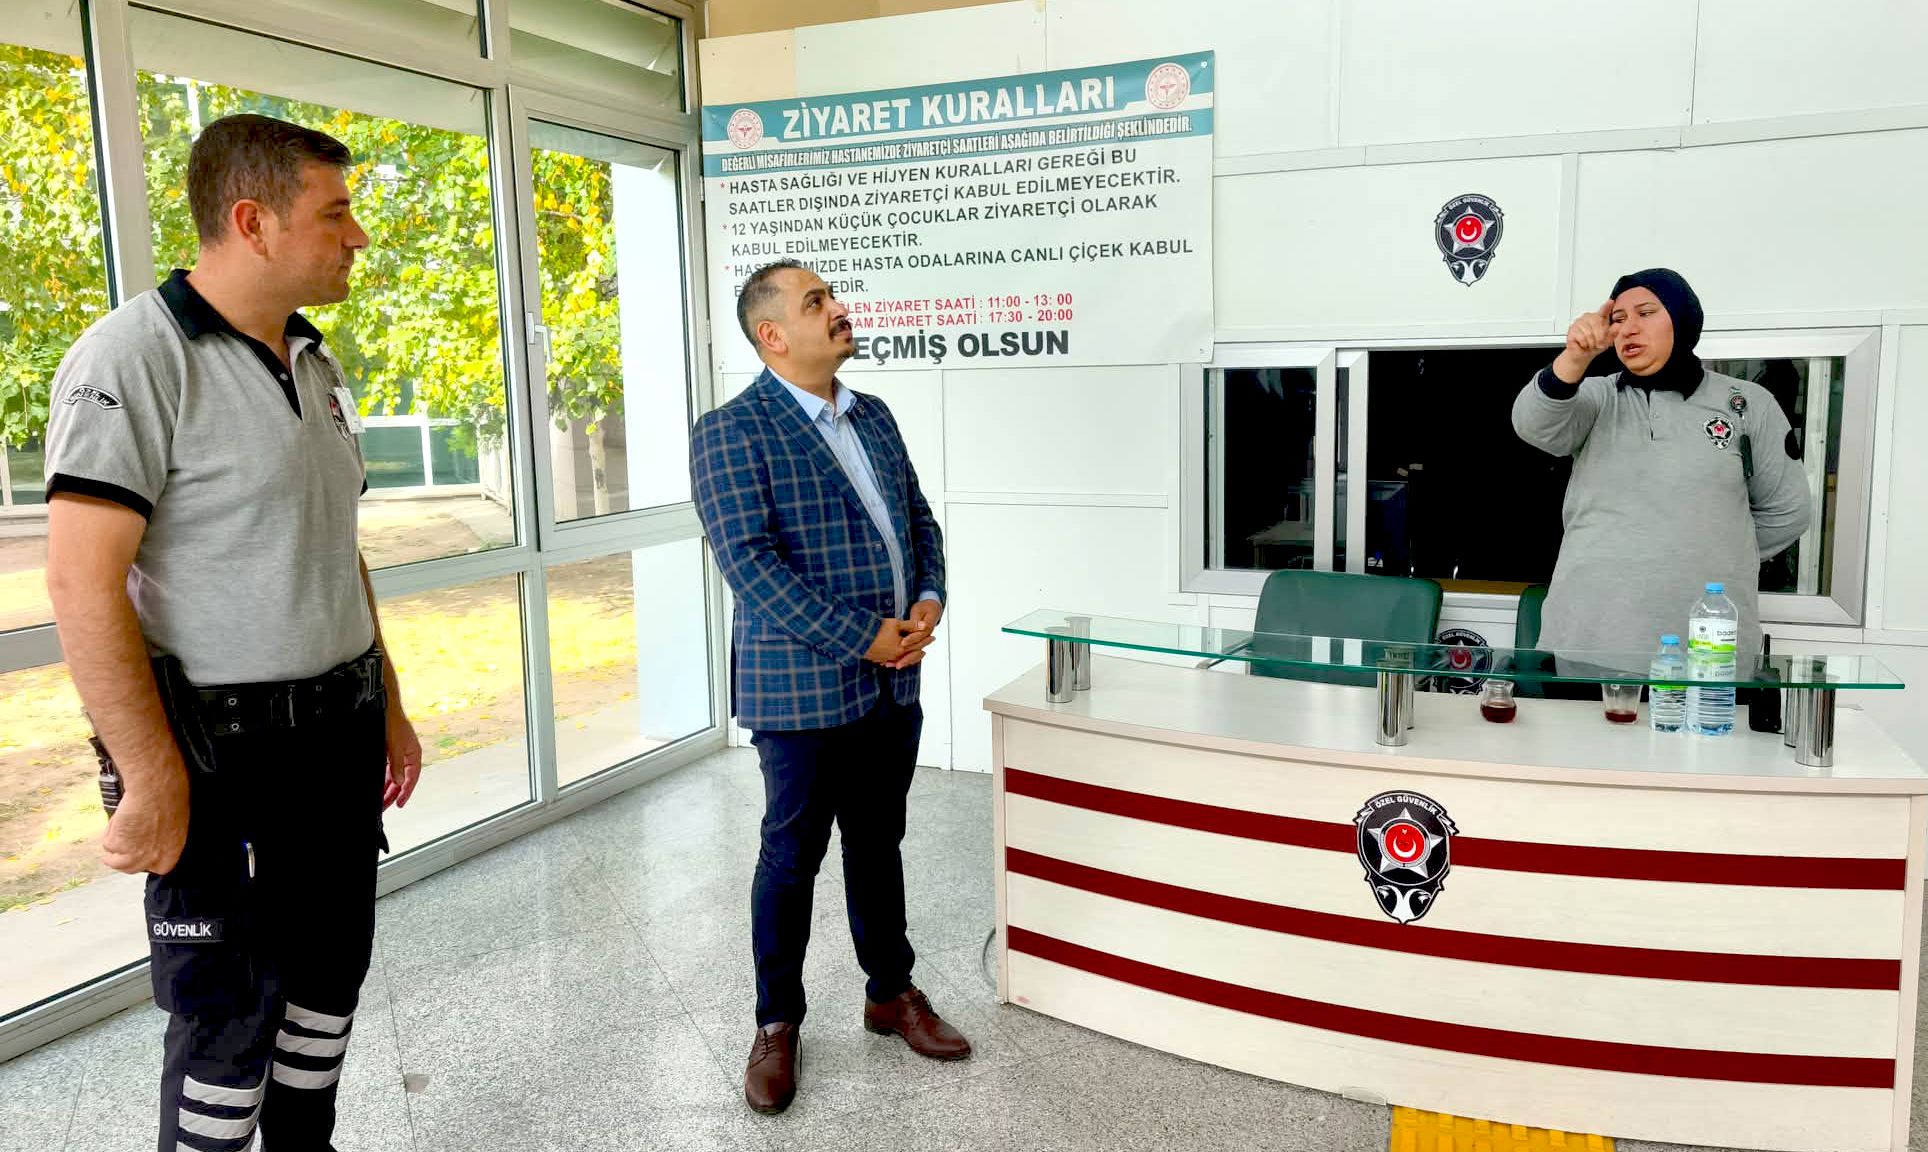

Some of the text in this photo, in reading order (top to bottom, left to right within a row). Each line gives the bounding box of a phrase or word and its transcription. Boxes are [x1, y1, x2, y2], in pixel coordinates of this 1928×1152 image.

[783, 76, 1114, 138] ZİYARET KURALLARI
[721, 155, 756, 172] DEĞERLİ
[831, 143, 900, 164] HASTANEMİZDE
[903, 137, 953, 157] ZİYARETÇİ
[953, 132, 999, 153] SAATLERİ
[1001, 130, 1046, 151] AŞAĞIDA
[1049, 118, 1115, 145] BELİRTİLDİĞİ
[1117, 115, 1193, 140] ŞEKLİNDEDİR.
[730, 148, 1136, 194] HASTA SAĞLIĞI VE HİJYEN KURALLARI GEREĞİ BU
[729, 167, 1180, 215] SAATLER DIŞINDA ZİYARETÇİ KABUL EDİLMEYECEKTİR.
[732, 194, 1157, 236] 12 YAŞINDAN KÜÇÜK ÇOCUKLAR ZİYARETÇİ OLARAK
[732, 231, 922, 256] KABUL EDİLMEYECEKTİR.
[852, 256, 903, 271] HASTA
[908, 250, 1006, 268] ODALARINA
[1011, 246, 1063, 262] CANLI
[1070, 242, 1123, 263] ÇİÇEK
[1130, 240, 1193, 256] KABUL
[875, 298, 930, 312] ZİYARET
[935, 295, 974, 311] SAATİ
[988, 295, 1020, 308] 11:00
[877, 314, 932, 328] ZİYARET
[937, 311, 977, 326] SAATİ
[989, 310, 1022, 323] 17:30
[1037, 309, 1073, 321] 20:00
[853, 329, 1069, 365] EÇMİŞ OLSUN
[1375, 795, 1438, 815] ÖZEL GÜVENLİK
[153, 921, 212, 937] GÜVENLİK
